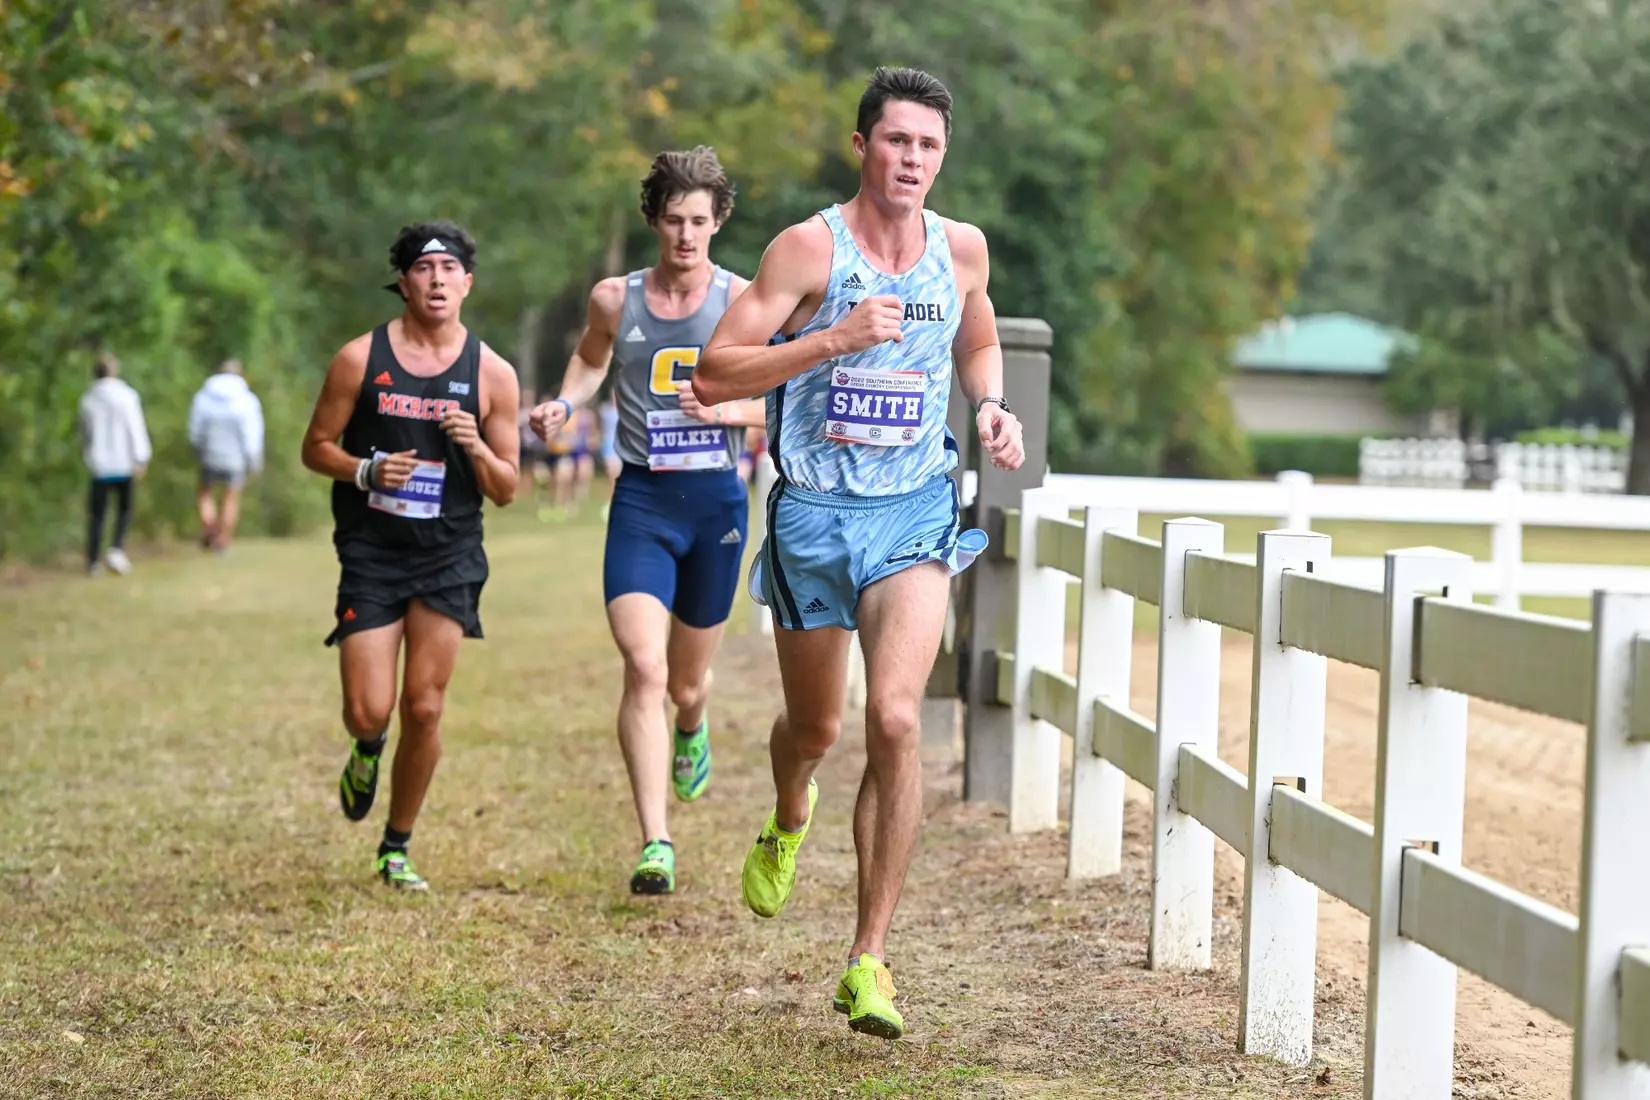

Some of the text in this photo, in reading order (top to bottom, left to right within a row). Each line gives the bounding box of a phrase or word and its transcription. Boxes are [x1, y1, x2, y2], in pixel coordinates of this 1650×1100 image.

[841, 282, 866, 291] adidas
[902, 302, 945, 322] ADEL
[833, 392, 920, 420] SMITH
[651, 429, 722, 447] MULKEY
[803, 606, 829, 614] adidas
